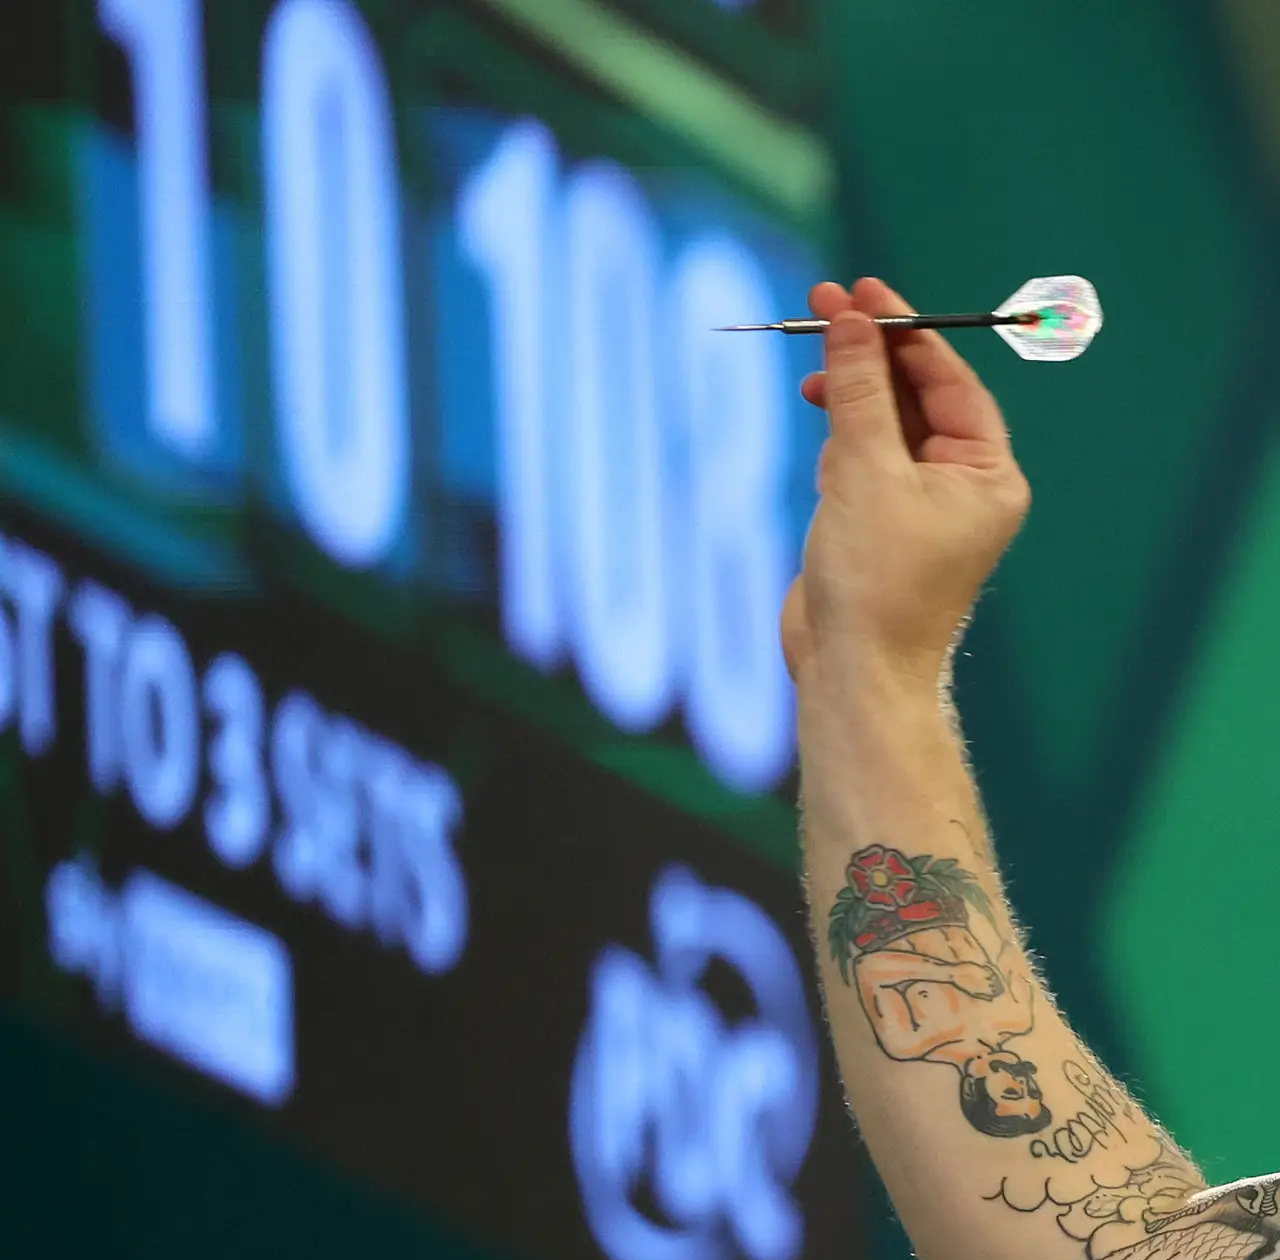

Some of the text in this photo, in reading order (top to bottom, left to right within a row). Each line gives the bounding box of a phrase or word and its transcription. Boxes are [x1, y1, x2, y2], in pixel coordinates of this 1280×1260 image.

[68, 580, 197, 828] TO
[203, 652, 270, 868] 3
[271, 690, 468, 974] SETS
